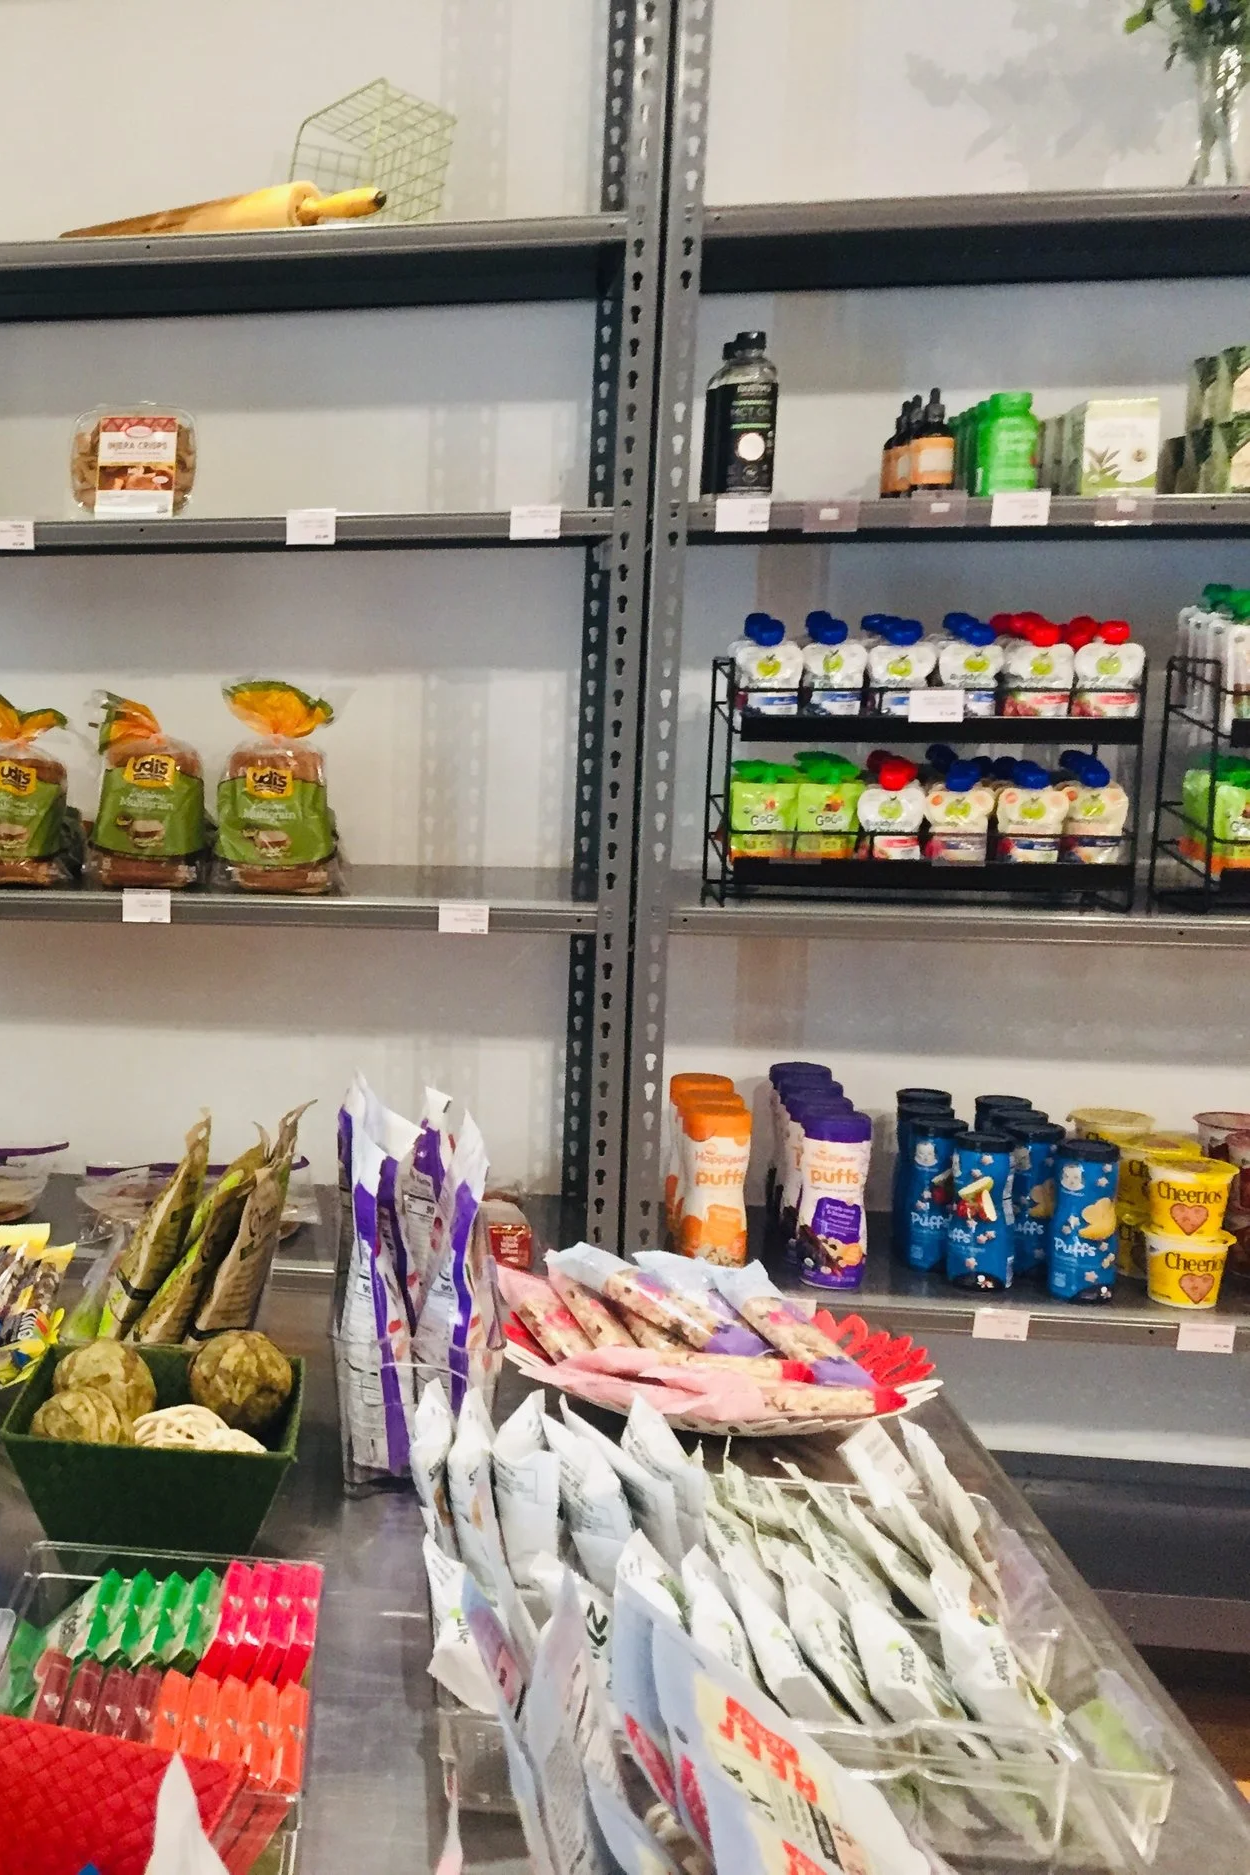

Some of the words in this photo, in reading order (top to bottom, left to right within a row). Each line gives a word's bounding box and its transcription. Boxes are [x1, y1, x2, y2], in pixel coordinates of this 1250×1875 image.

[695, 1168, 743, 1187] puffs
[810, 1168, 860, 1185] puffs
[1156, 1180, 1222, 1205] Cheerios
[1014, 1220, 1044, 1236] uffs
[1054, 1236, 1097, 1258] Puffs
[1164, 1251, 1224, 1273] Cheerio
